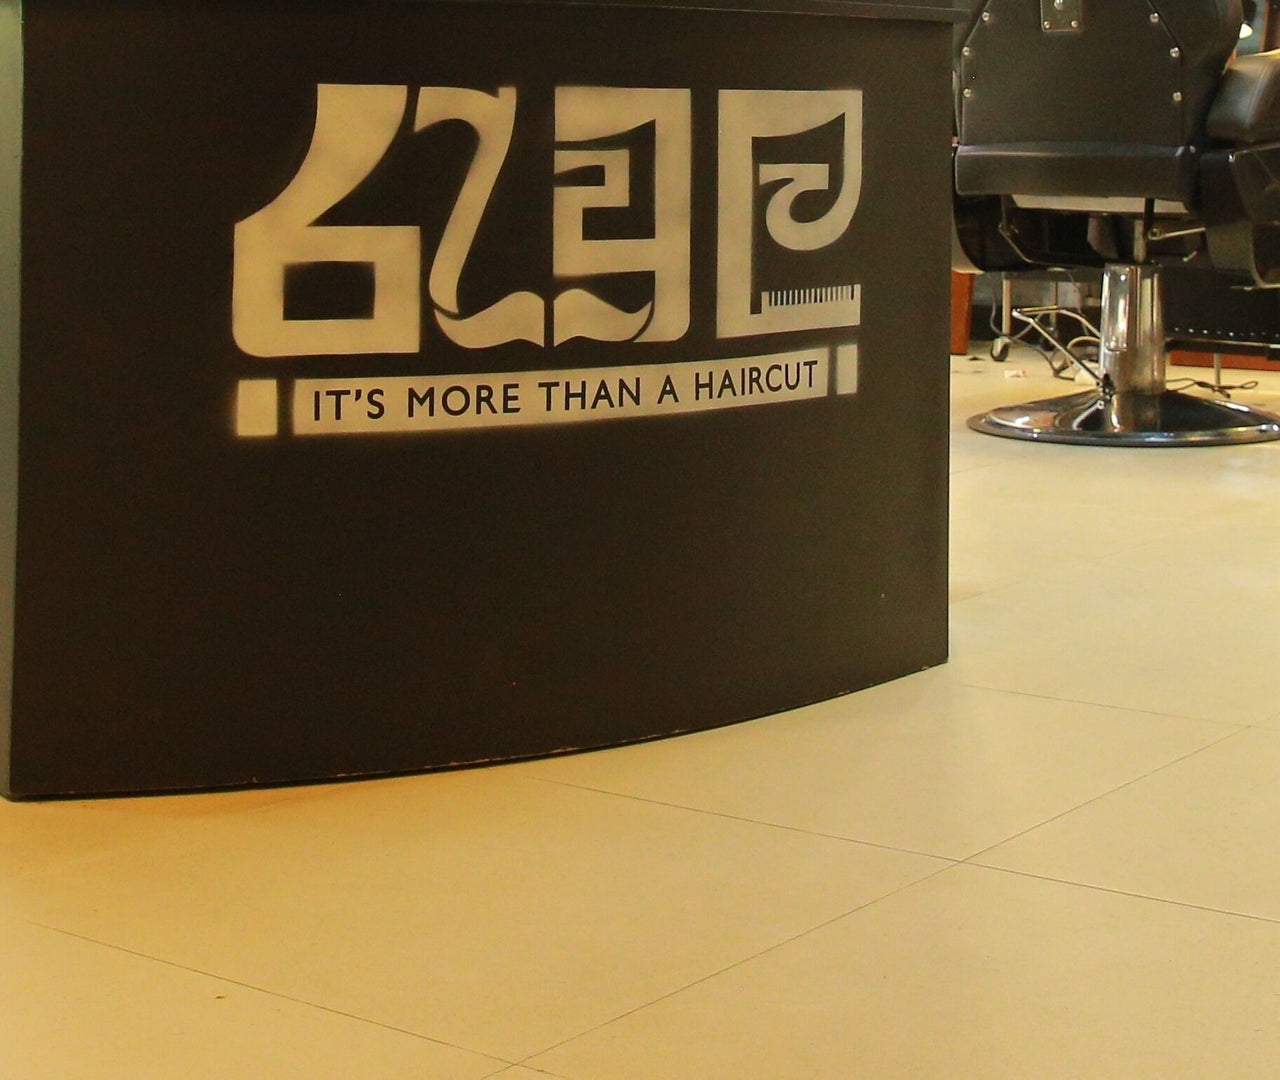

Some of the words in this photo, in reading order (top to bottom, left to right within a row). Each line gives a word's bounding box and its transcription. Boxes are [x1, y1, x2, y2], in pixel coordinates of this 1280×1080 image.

[407, 383, 521, 418] MORE
[538, 376, 641, 411] THAN
[657, 375, 680, 404] A
[694, 360, 819, 402] HAIRCUT
